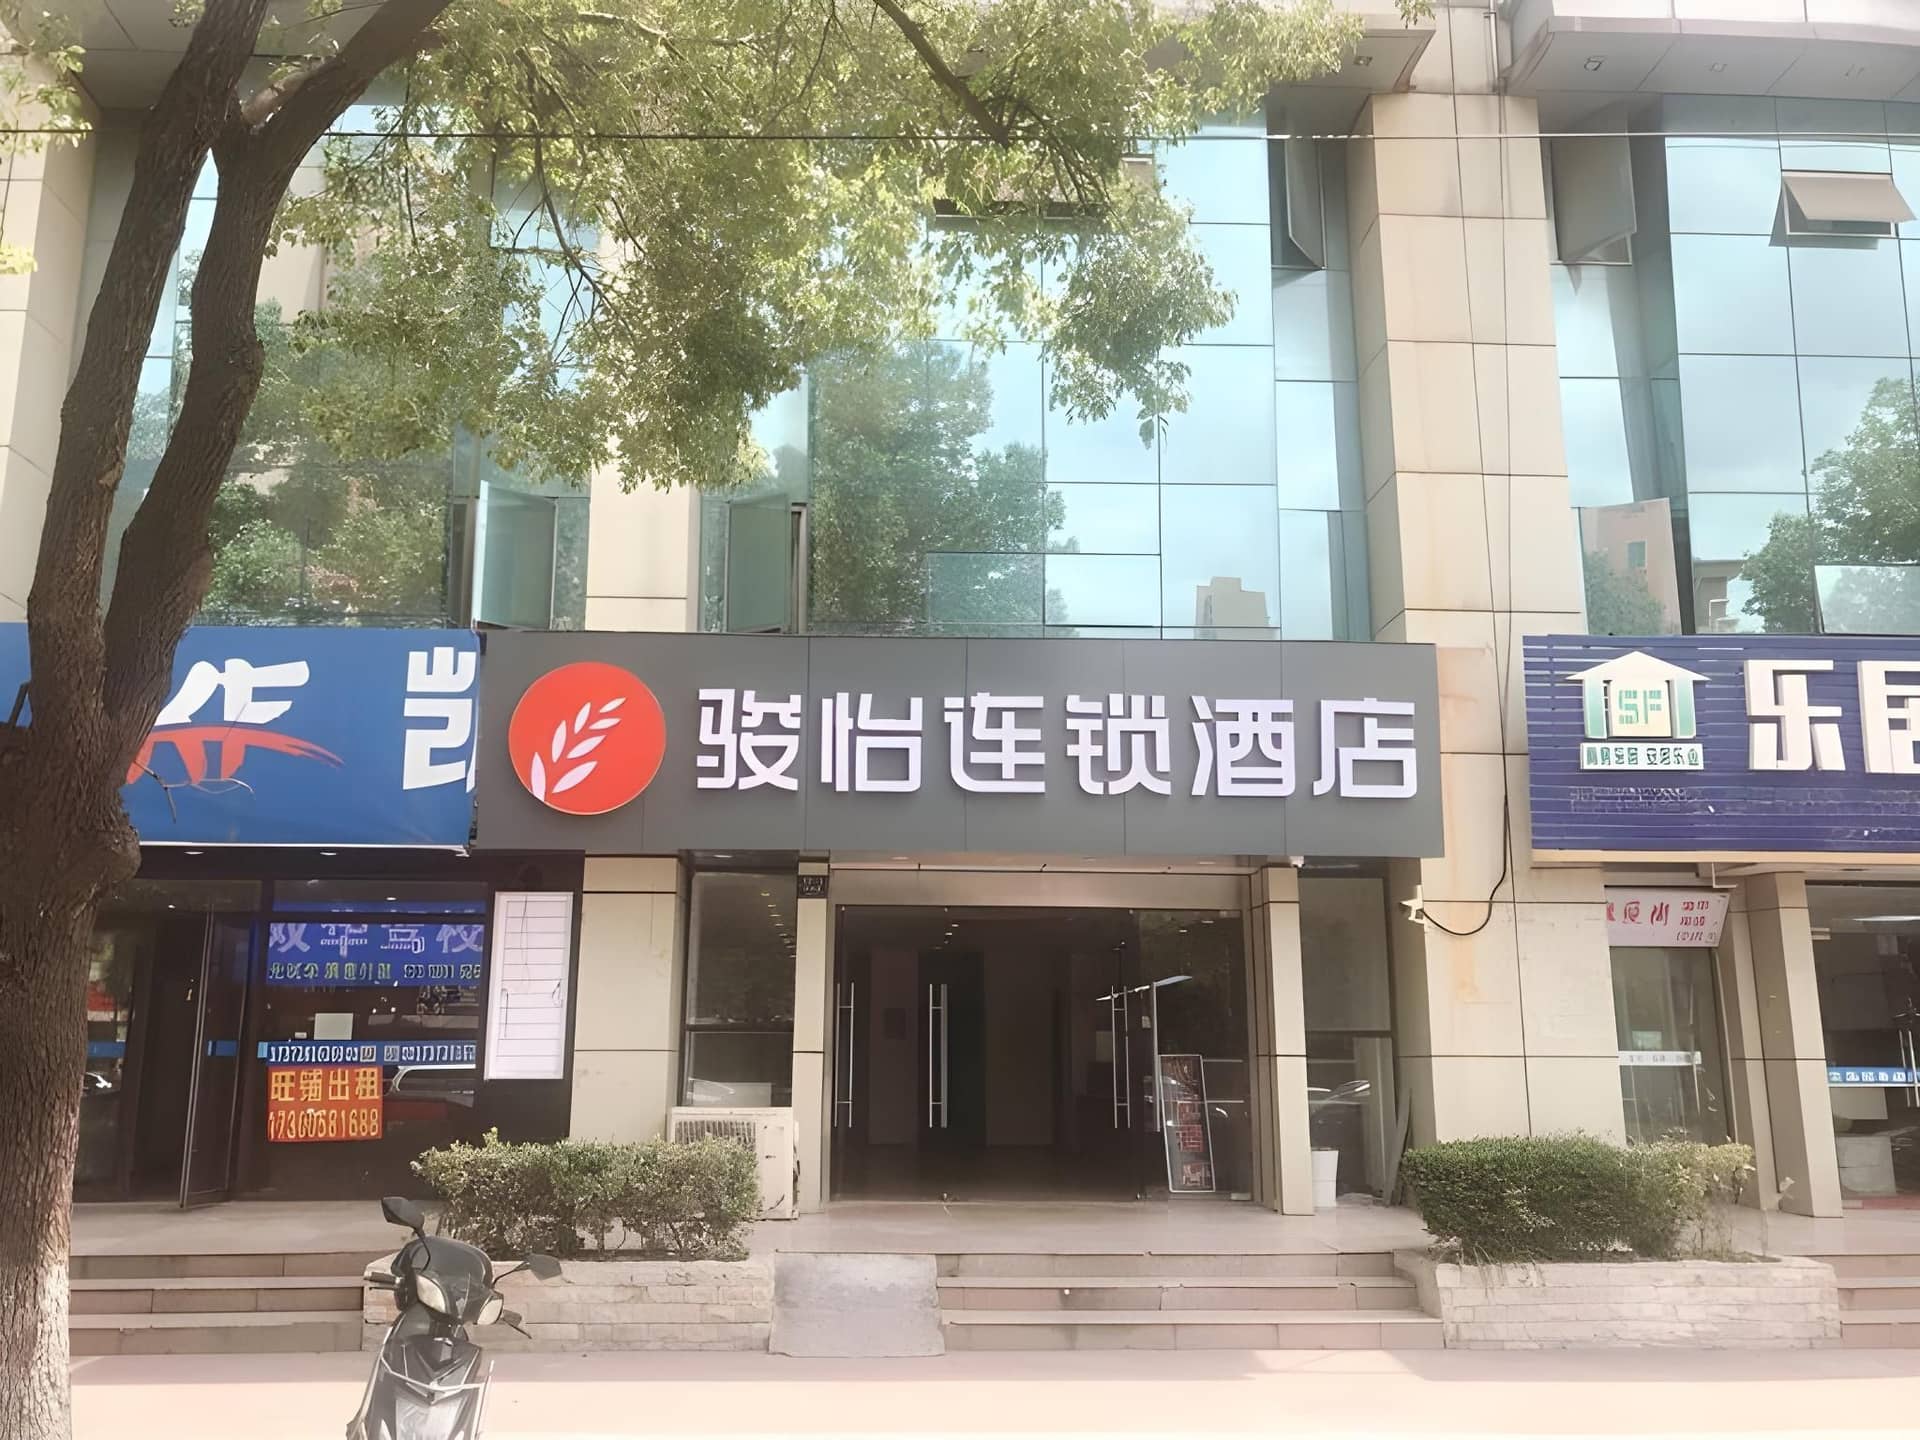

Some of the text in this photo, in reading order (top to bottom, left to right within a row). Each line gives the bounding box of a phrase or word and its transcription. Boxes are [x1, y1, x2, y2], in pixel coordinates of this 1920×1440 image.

[697, 688, 1417, 799] 骏怡连锁酒店
